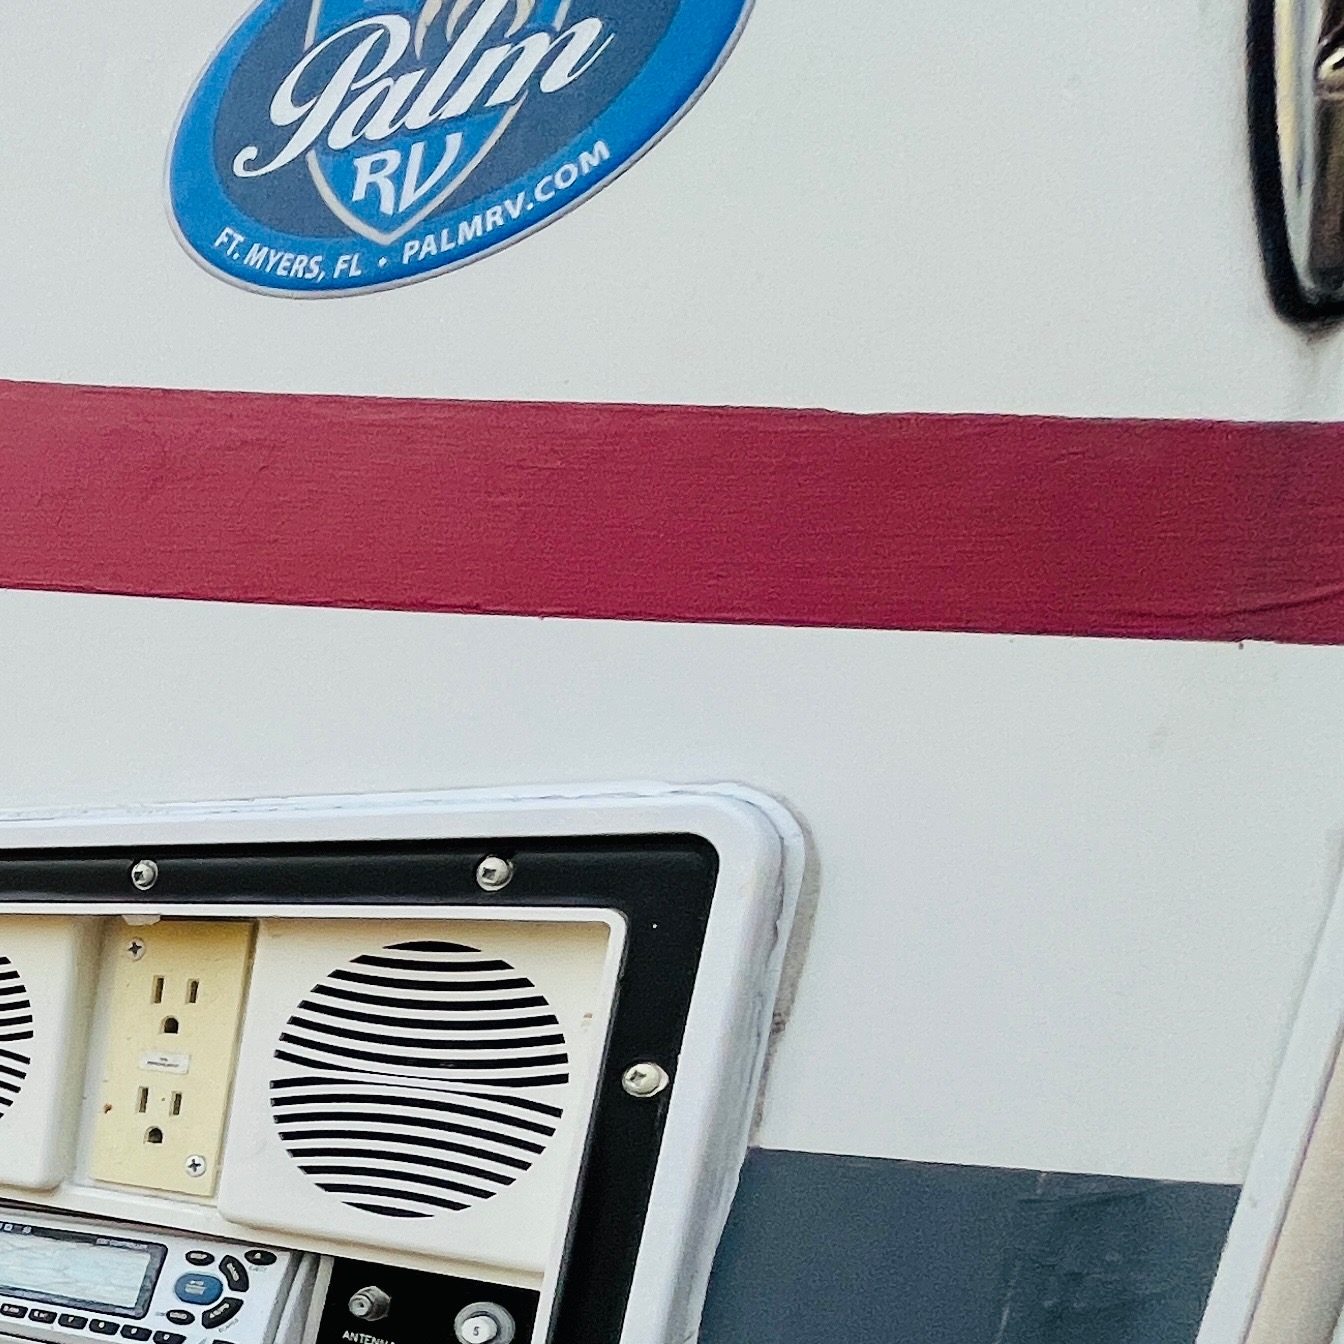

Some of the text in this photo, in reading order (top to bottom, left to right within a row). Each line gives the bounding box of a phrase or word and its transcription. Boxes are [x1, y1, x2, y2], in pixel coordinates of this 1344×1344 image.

[232, 0, 614, 178] Palm
[213, 137, 612, 283] FT. MYERS, FL PALMRV.COM
[351, 131, 461, 217] RV
